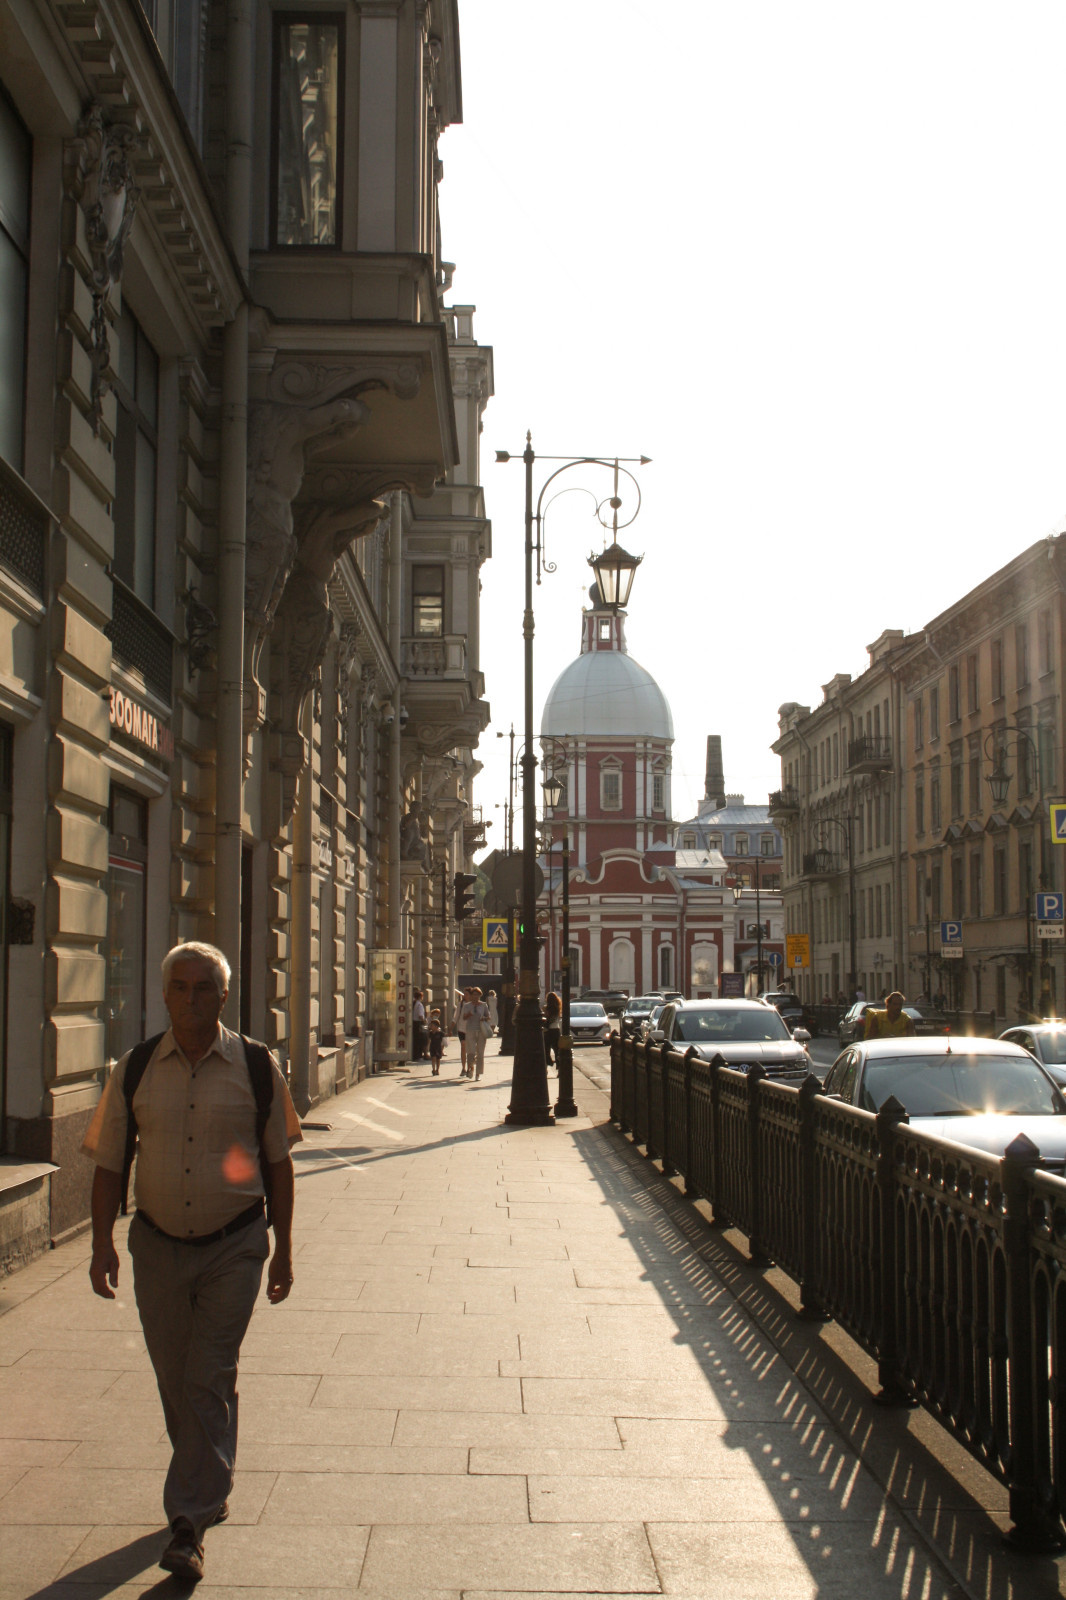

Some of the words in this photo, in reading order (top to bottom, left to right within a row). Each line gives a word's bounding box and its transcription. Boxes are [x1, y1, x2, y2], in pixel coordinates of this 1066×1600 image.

[1043, 896, 1058, 918] P
[947, 924, 958, 941] P
[398, 956, 406, 1049] СТОЛОВАЯ
